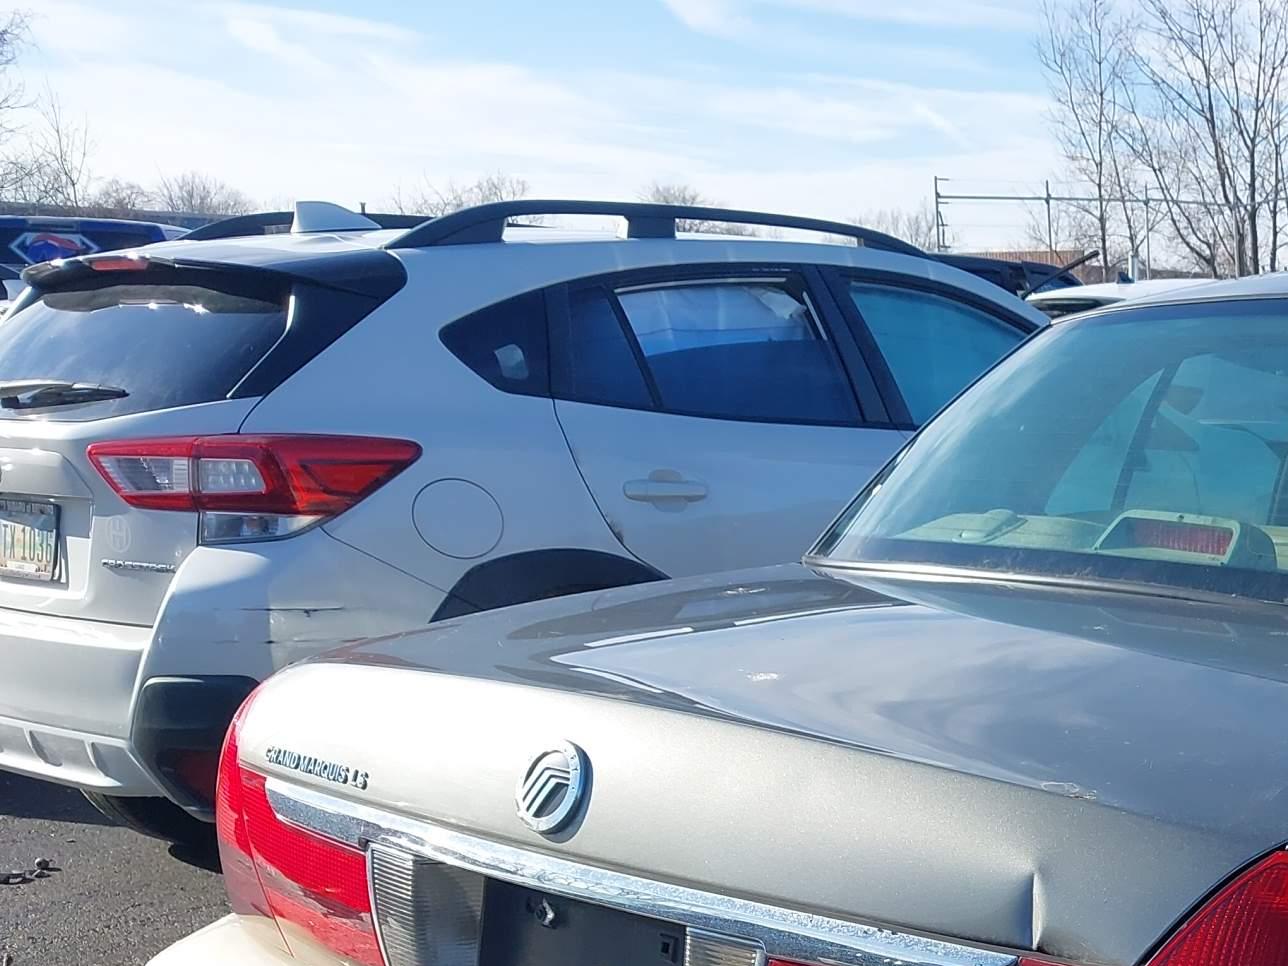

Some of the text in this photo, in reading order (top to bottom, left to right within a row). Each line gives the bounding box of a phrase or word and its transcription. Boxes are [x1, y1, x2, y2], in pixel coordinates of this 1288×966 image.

[265, 746, 369, 790] GRAND MARQUIS LS
